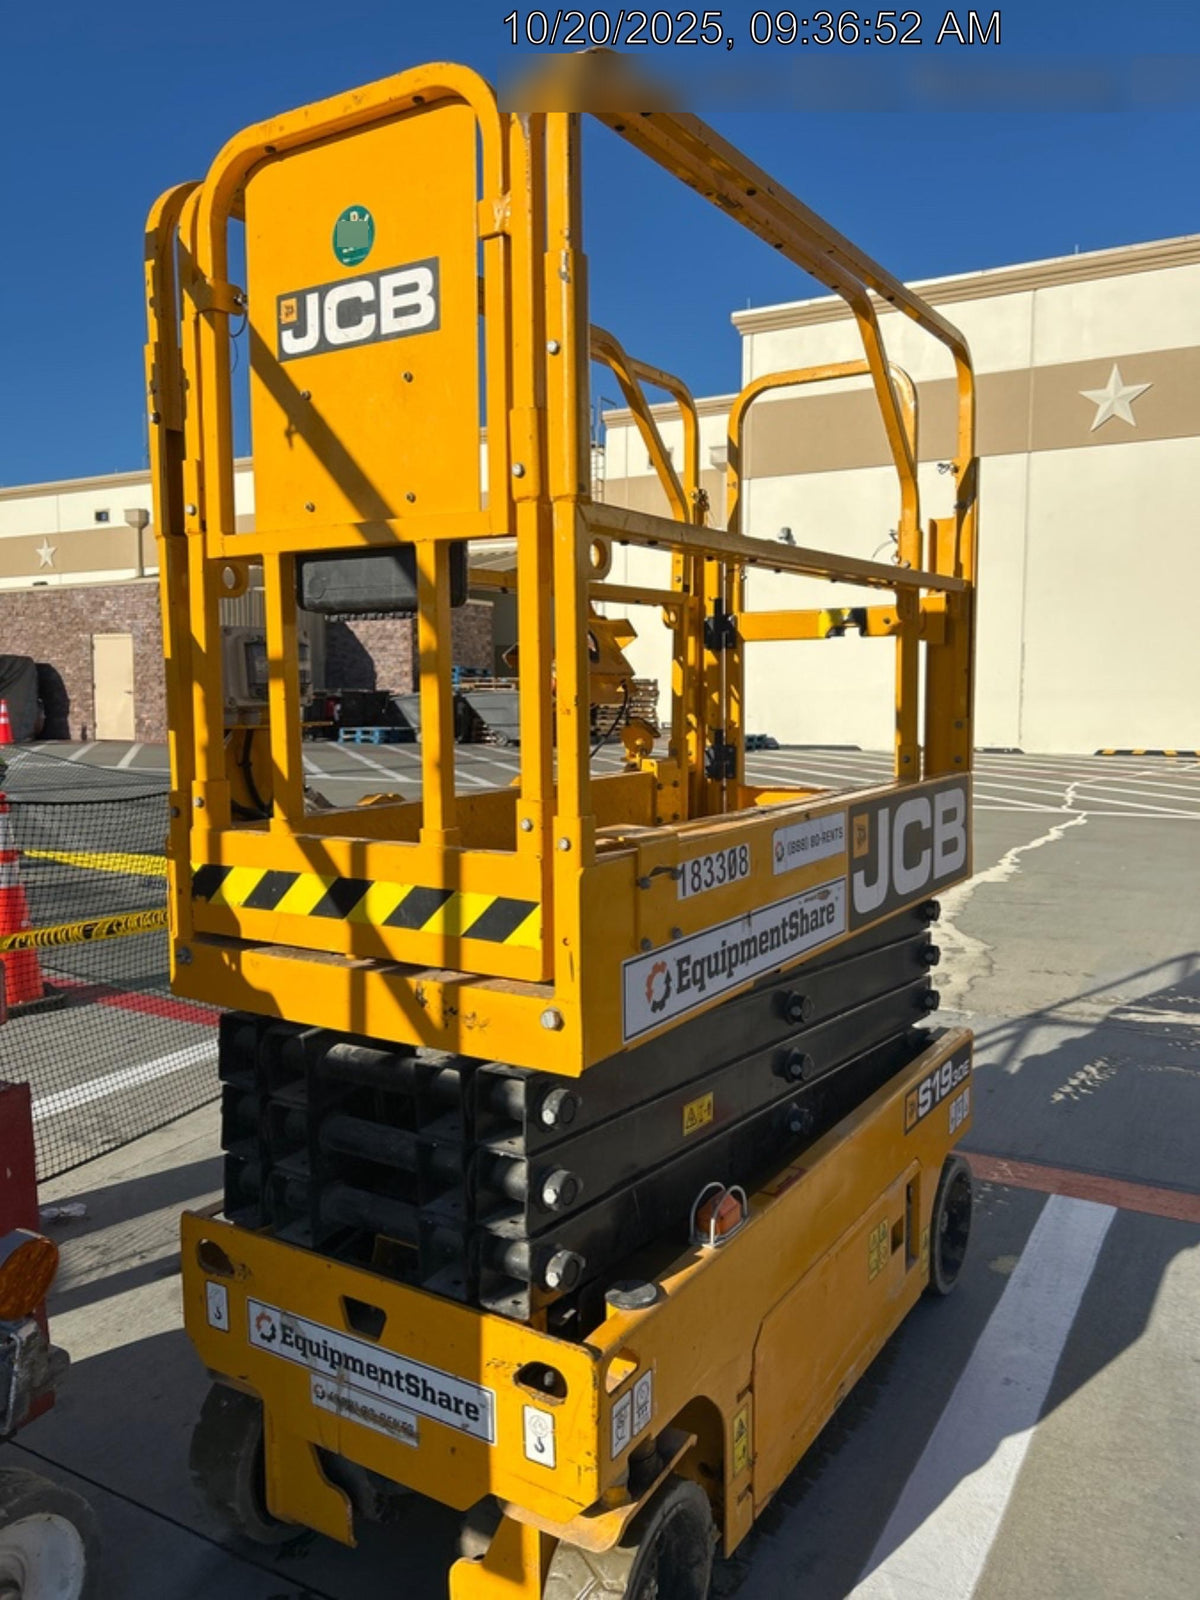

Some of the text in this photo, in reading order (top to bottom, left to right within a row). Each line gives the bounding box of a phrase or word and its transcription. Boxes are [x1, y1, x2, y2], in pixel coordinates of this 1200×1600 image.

[280, 266, 437, 355] JCB
[679, 844, 749, 897] 183308
[852, 787, 967, 915] JCB
[676, 901, 835, 995] EquipmentShare
[280, 1323, 481, 1423] EquipmentShare
